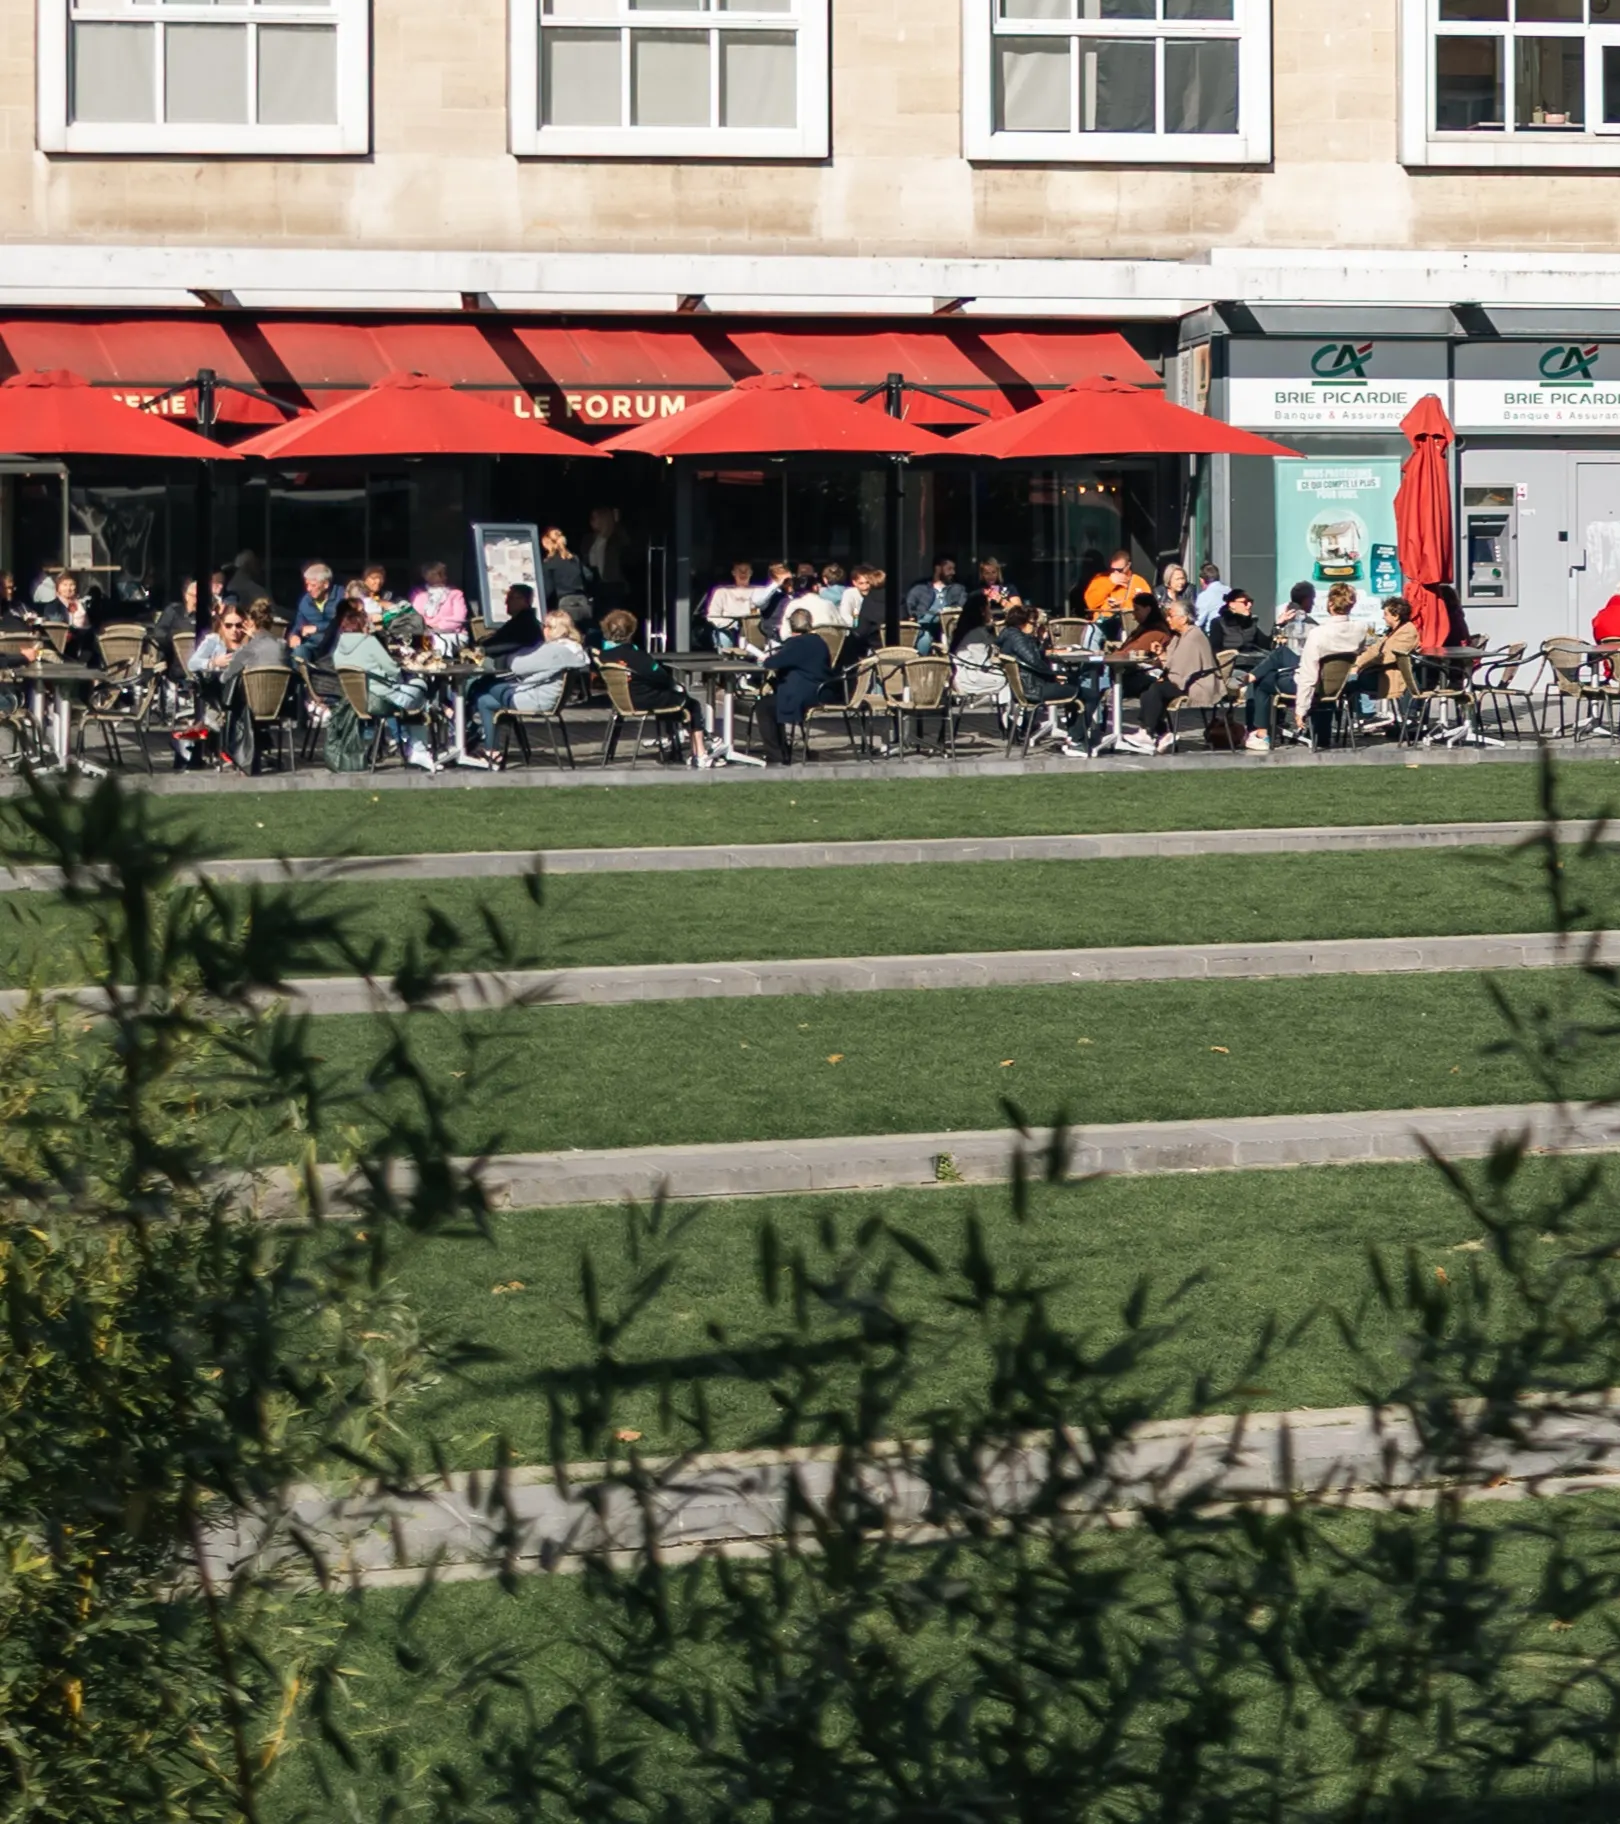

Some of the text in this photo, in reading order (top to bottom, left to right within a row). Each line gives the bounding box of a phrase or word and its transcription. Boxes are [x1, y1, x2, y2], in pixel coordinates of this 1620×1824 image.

[1275, 392, 1408, 404] BRIE PICARDIE
[1504, 393, 1544, 404] BRIE
[514, 395, 686, 419] LE FORUM
[1274, 410, 1322, 420] Banque
[1329, 410, 1336, 420] &
[1503, 411, 1550, 421] Banque
[1556, 411, 1563, 420] &
